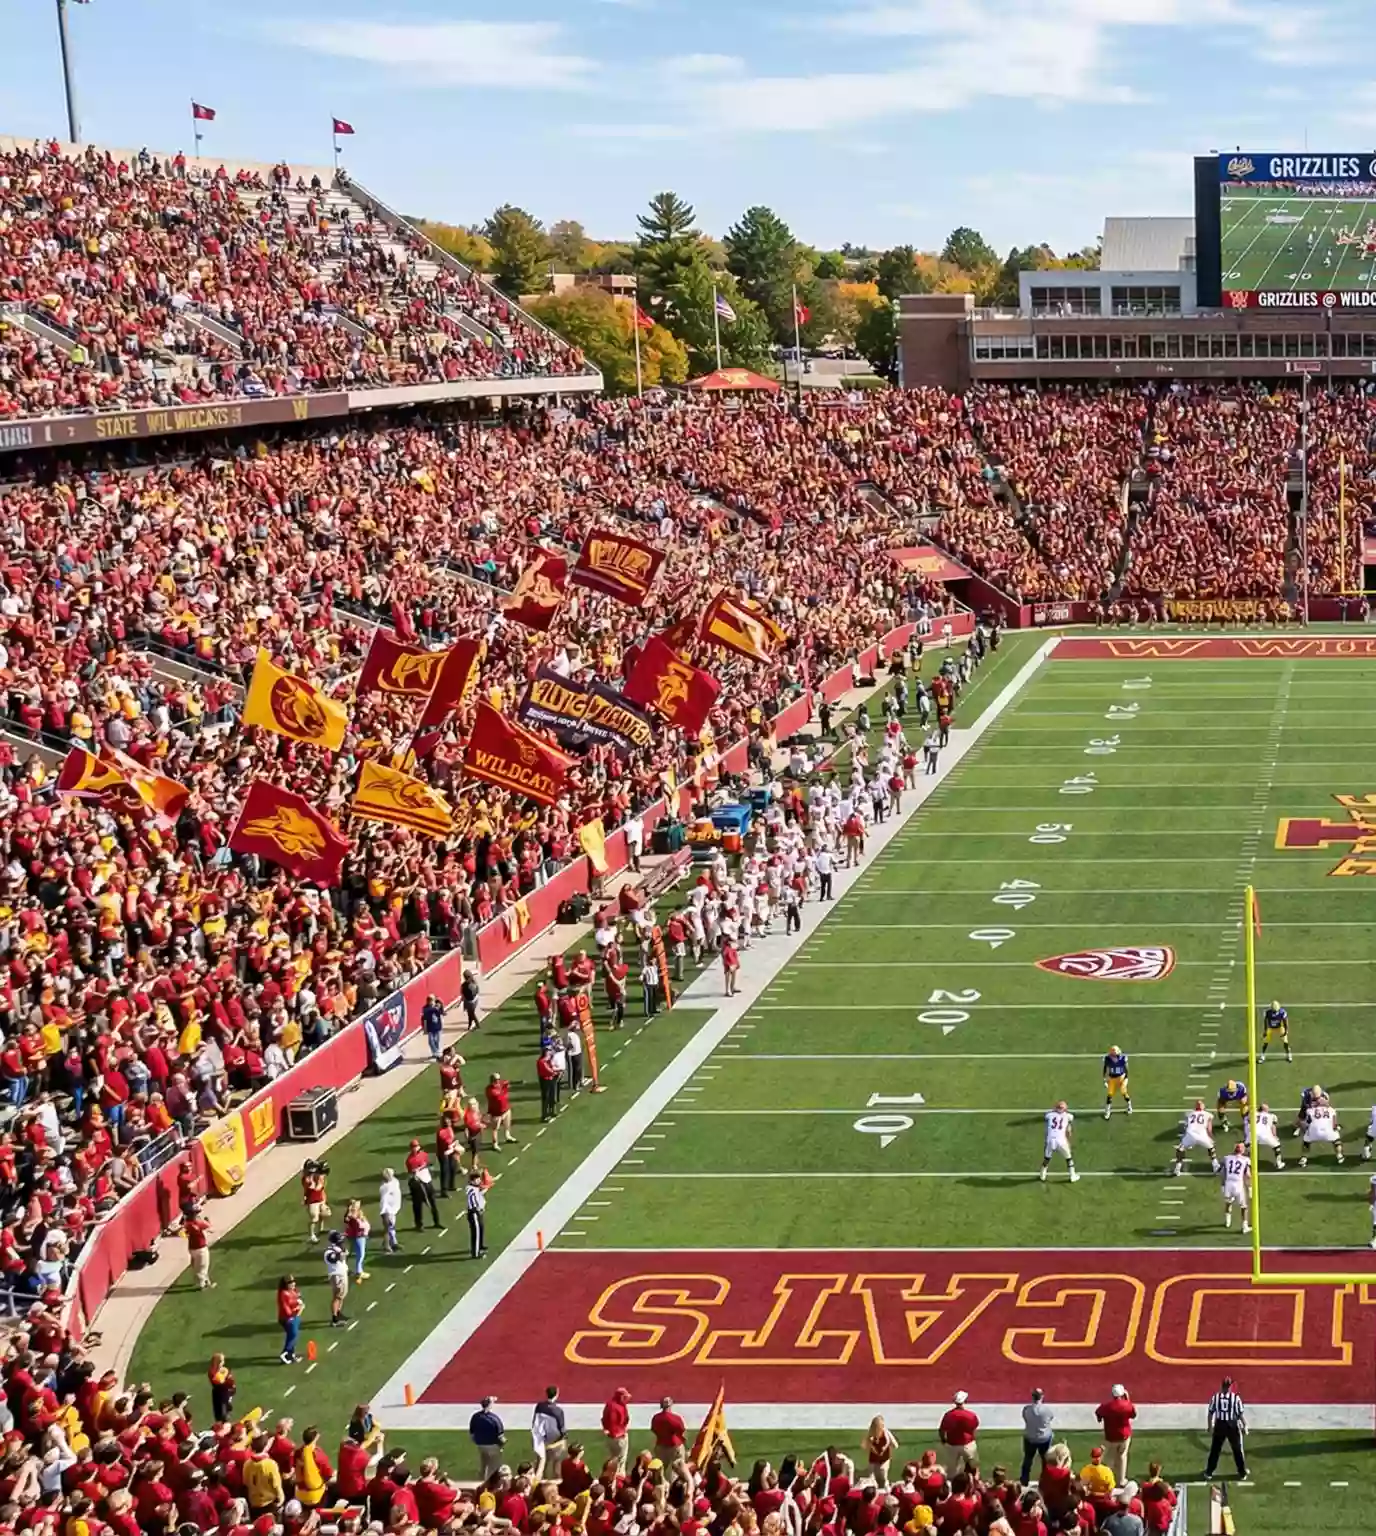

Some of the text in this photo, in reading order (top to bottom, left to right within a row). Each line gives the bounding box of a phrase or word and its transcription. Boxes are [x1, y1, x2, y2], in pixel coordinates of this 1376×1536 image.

[1269, 157, 1360, 178] GRIZZLIES
[1258, 292, 1318, 307] GRIZZLIES
[1322, 293, 1337, 307] @
[96, 416, 138, 438] STATE
[1099, 640, 1211, 656] W
[916, 988, 982, 1025] 20
[853, 1092, 926, 1134] 10
[1228, 1160, 1243, 1175] 12
